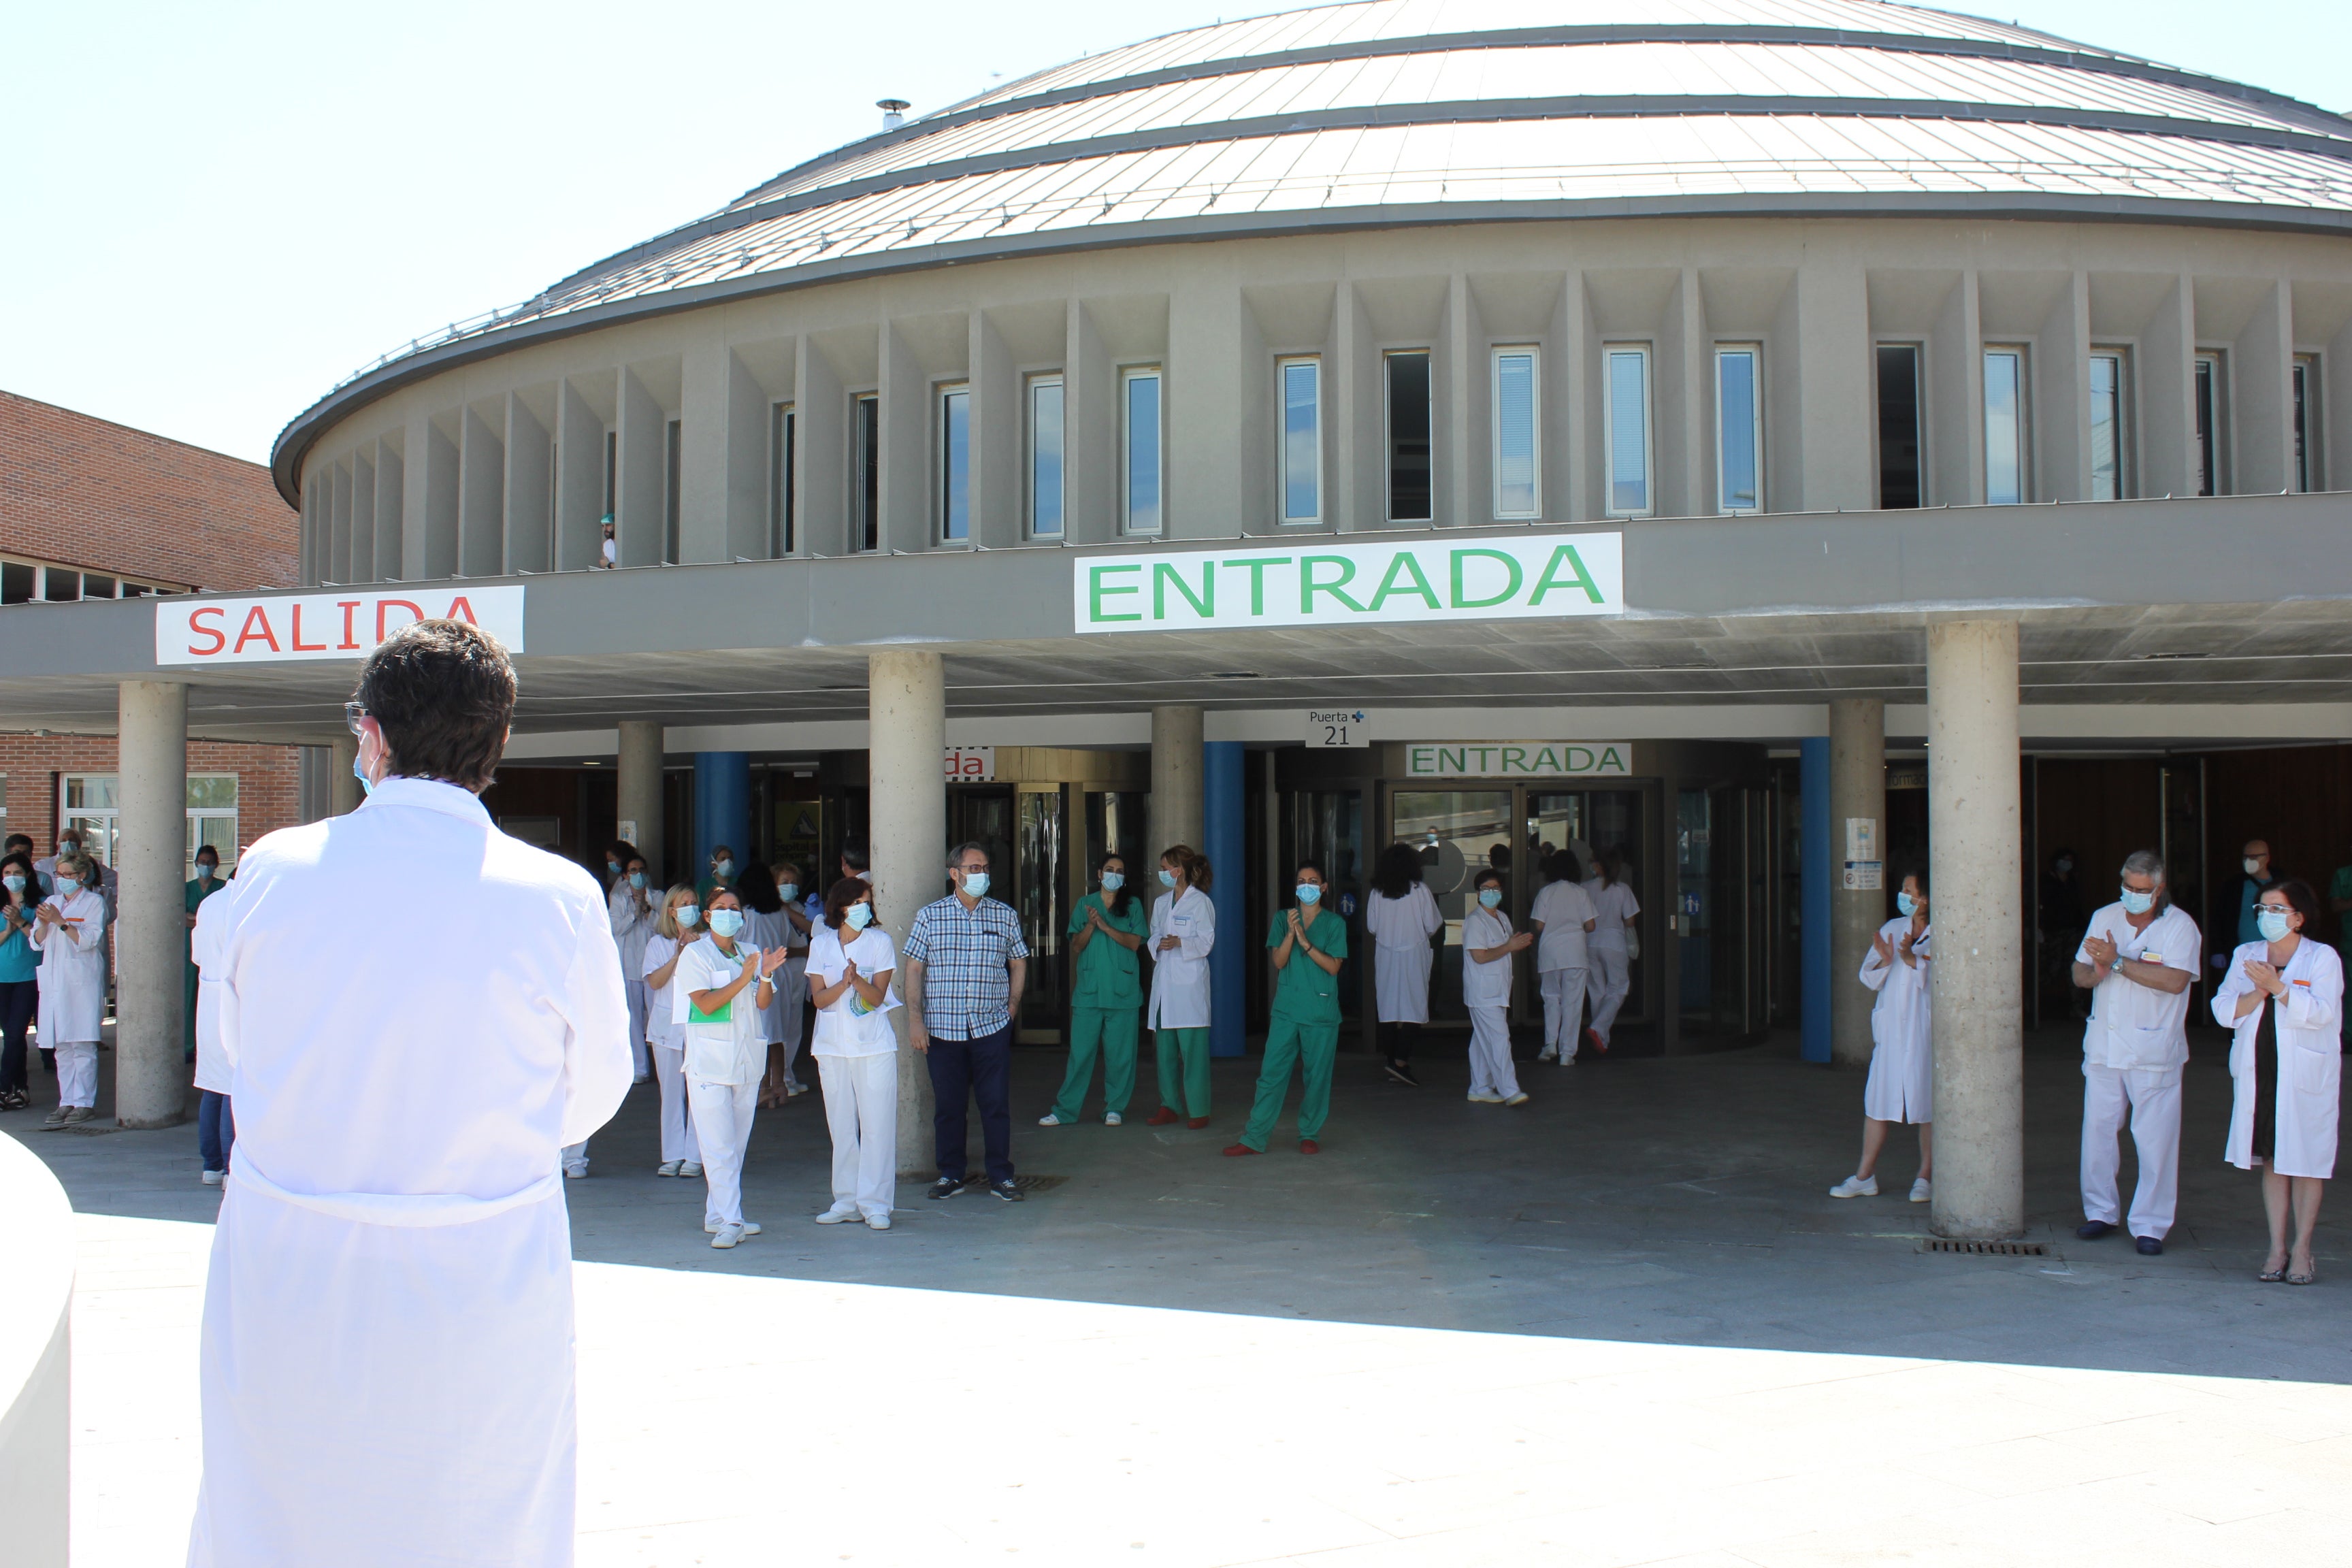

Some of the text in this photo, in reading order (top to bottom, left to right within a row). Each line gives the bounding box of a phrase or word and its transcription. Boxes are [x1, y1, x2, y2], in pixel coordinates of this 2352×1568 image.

[1089, 544, 1605, 623] ENTRADA
[1310, 711, 1348, 722] Puerta
[1324, 725, 1349, 745] 21
[1411, 747, 1625, 773] ENTRADA
